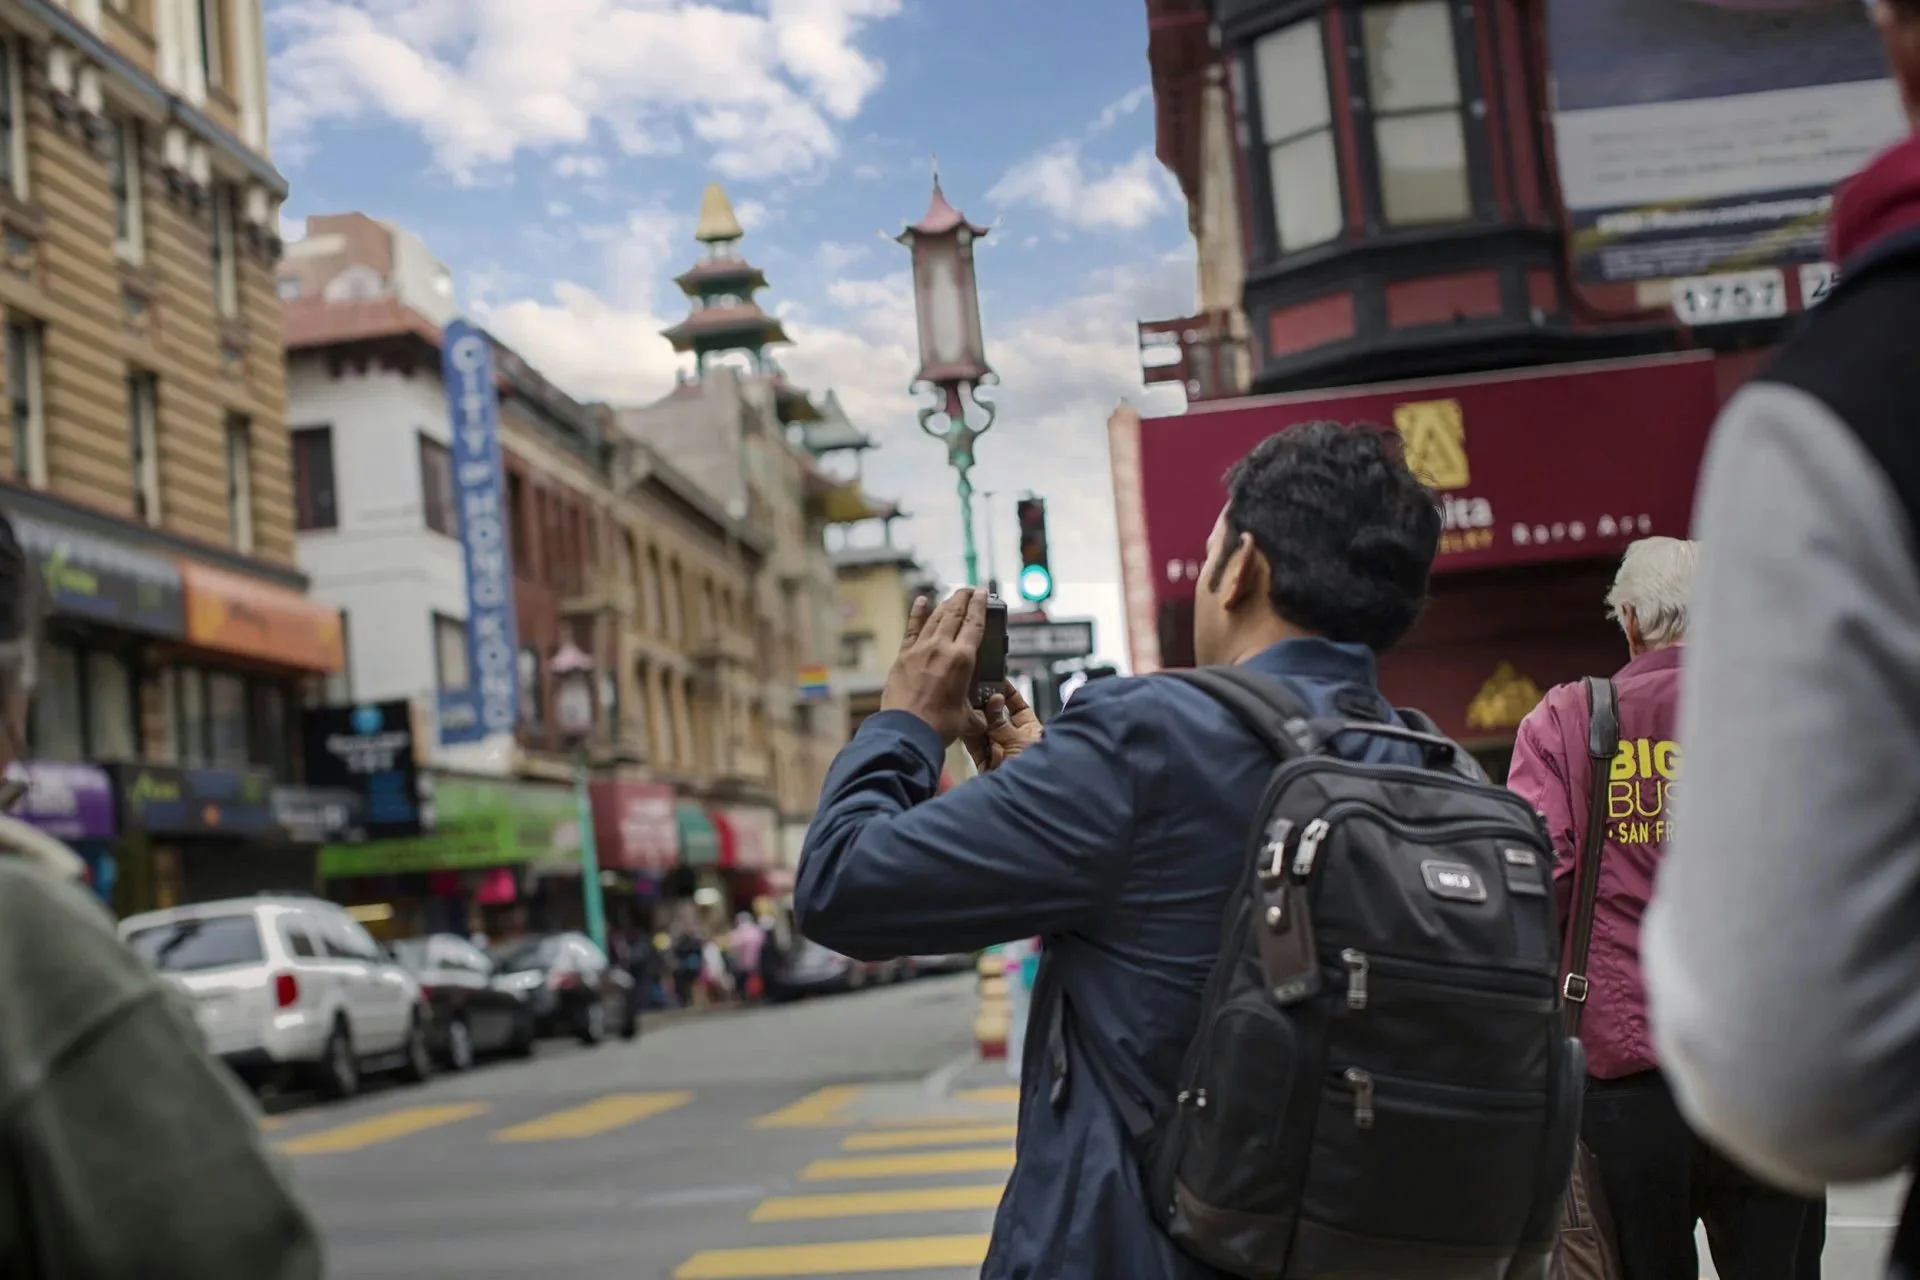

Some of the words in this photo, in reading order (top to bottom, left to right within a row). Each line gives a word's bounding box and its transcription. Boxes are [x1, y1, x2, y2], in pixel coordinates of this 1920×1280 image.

[451, 335, 487, 457] CITY
[1437, 493, 1493, 530] ita
[465, 489, 504, 609] HONG
[475, 610, 516, 734] KONG
[1609, 738, 1685, 781] BIG
[1607, 780, 1681, 818] BUS
[1618, 821, 1650, 843] SAN
[1656, 820, 1675, 843] FR
